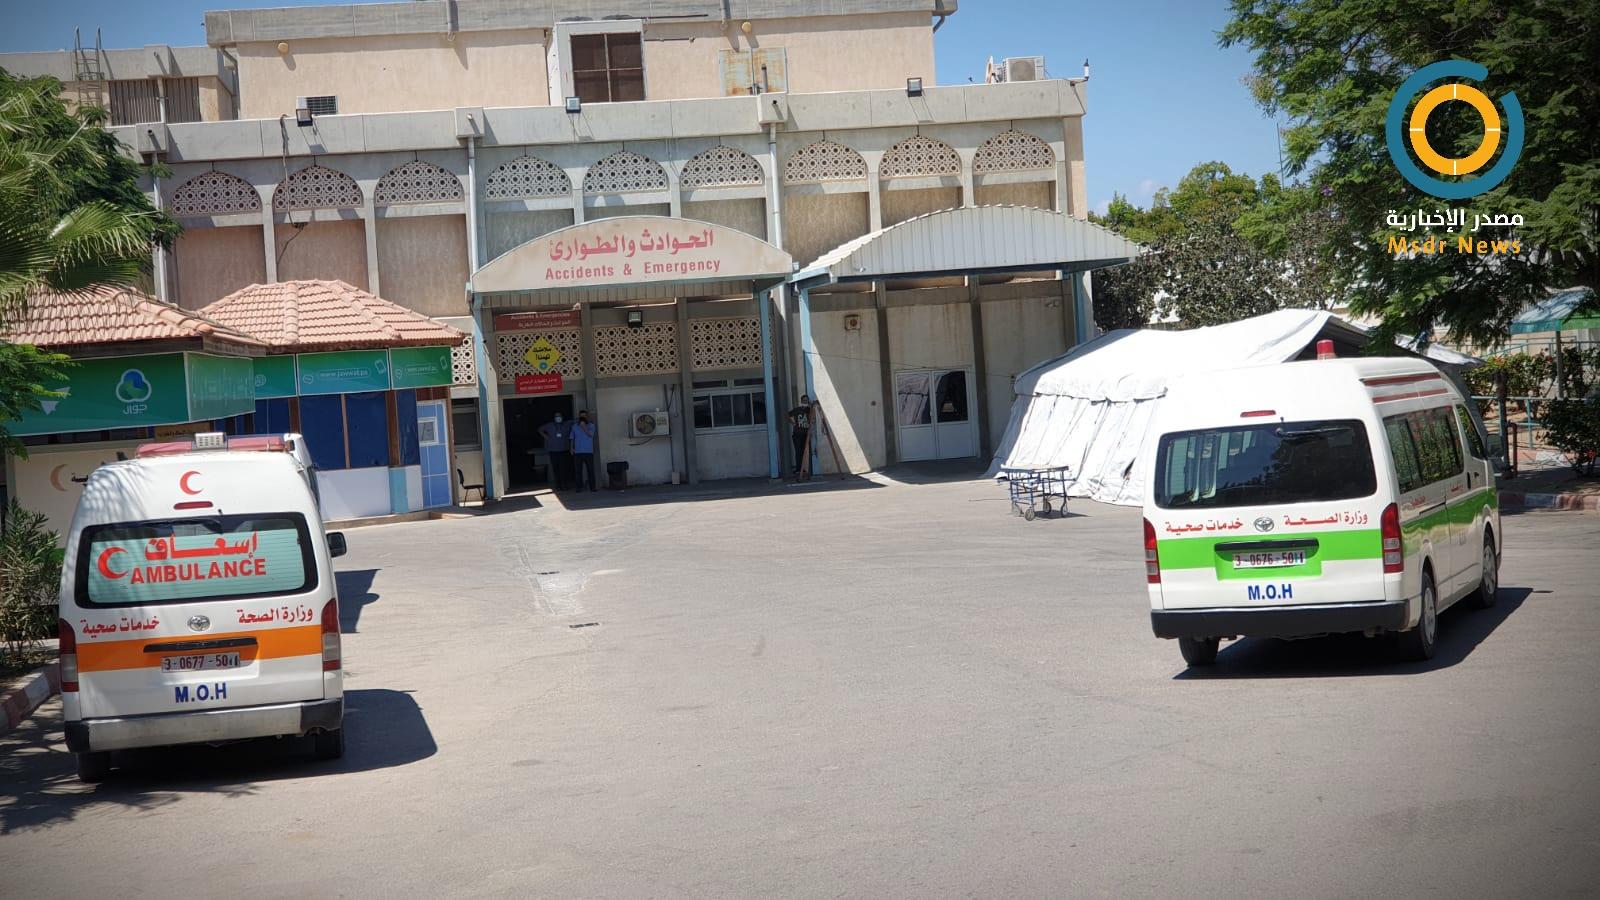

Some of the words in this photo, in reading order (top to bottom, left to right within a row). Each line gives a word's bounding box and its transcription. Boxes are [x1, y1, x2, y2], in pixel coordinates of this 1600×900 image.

[550, 231, 636, 261] والطوارئ
[639, 228, 714, 255] الحوادث
[545, 265, 614, 281] Accidents
[623, 263, 632, 276] &
[644, 259, 721, 274] Emergency
[1206, 517, 1244, 531] خدمات
[1284, 513, 1342, 526] الصحة
[1344, 511, 1368, 525] وزارة
[1165, 521, 1203, 535] صحية
[130, 558, 267, 585] AMBULANCE
[1247, 583, 1293, 601] M.O.H
[237, 607, 280, 624] الصحة
[282, 604, 313, 623] وزارة
[80, 619, 117, 638] صحية
[119, 615, 160, 633] خدمات
[174, 682, 227, 703] M.O.H
